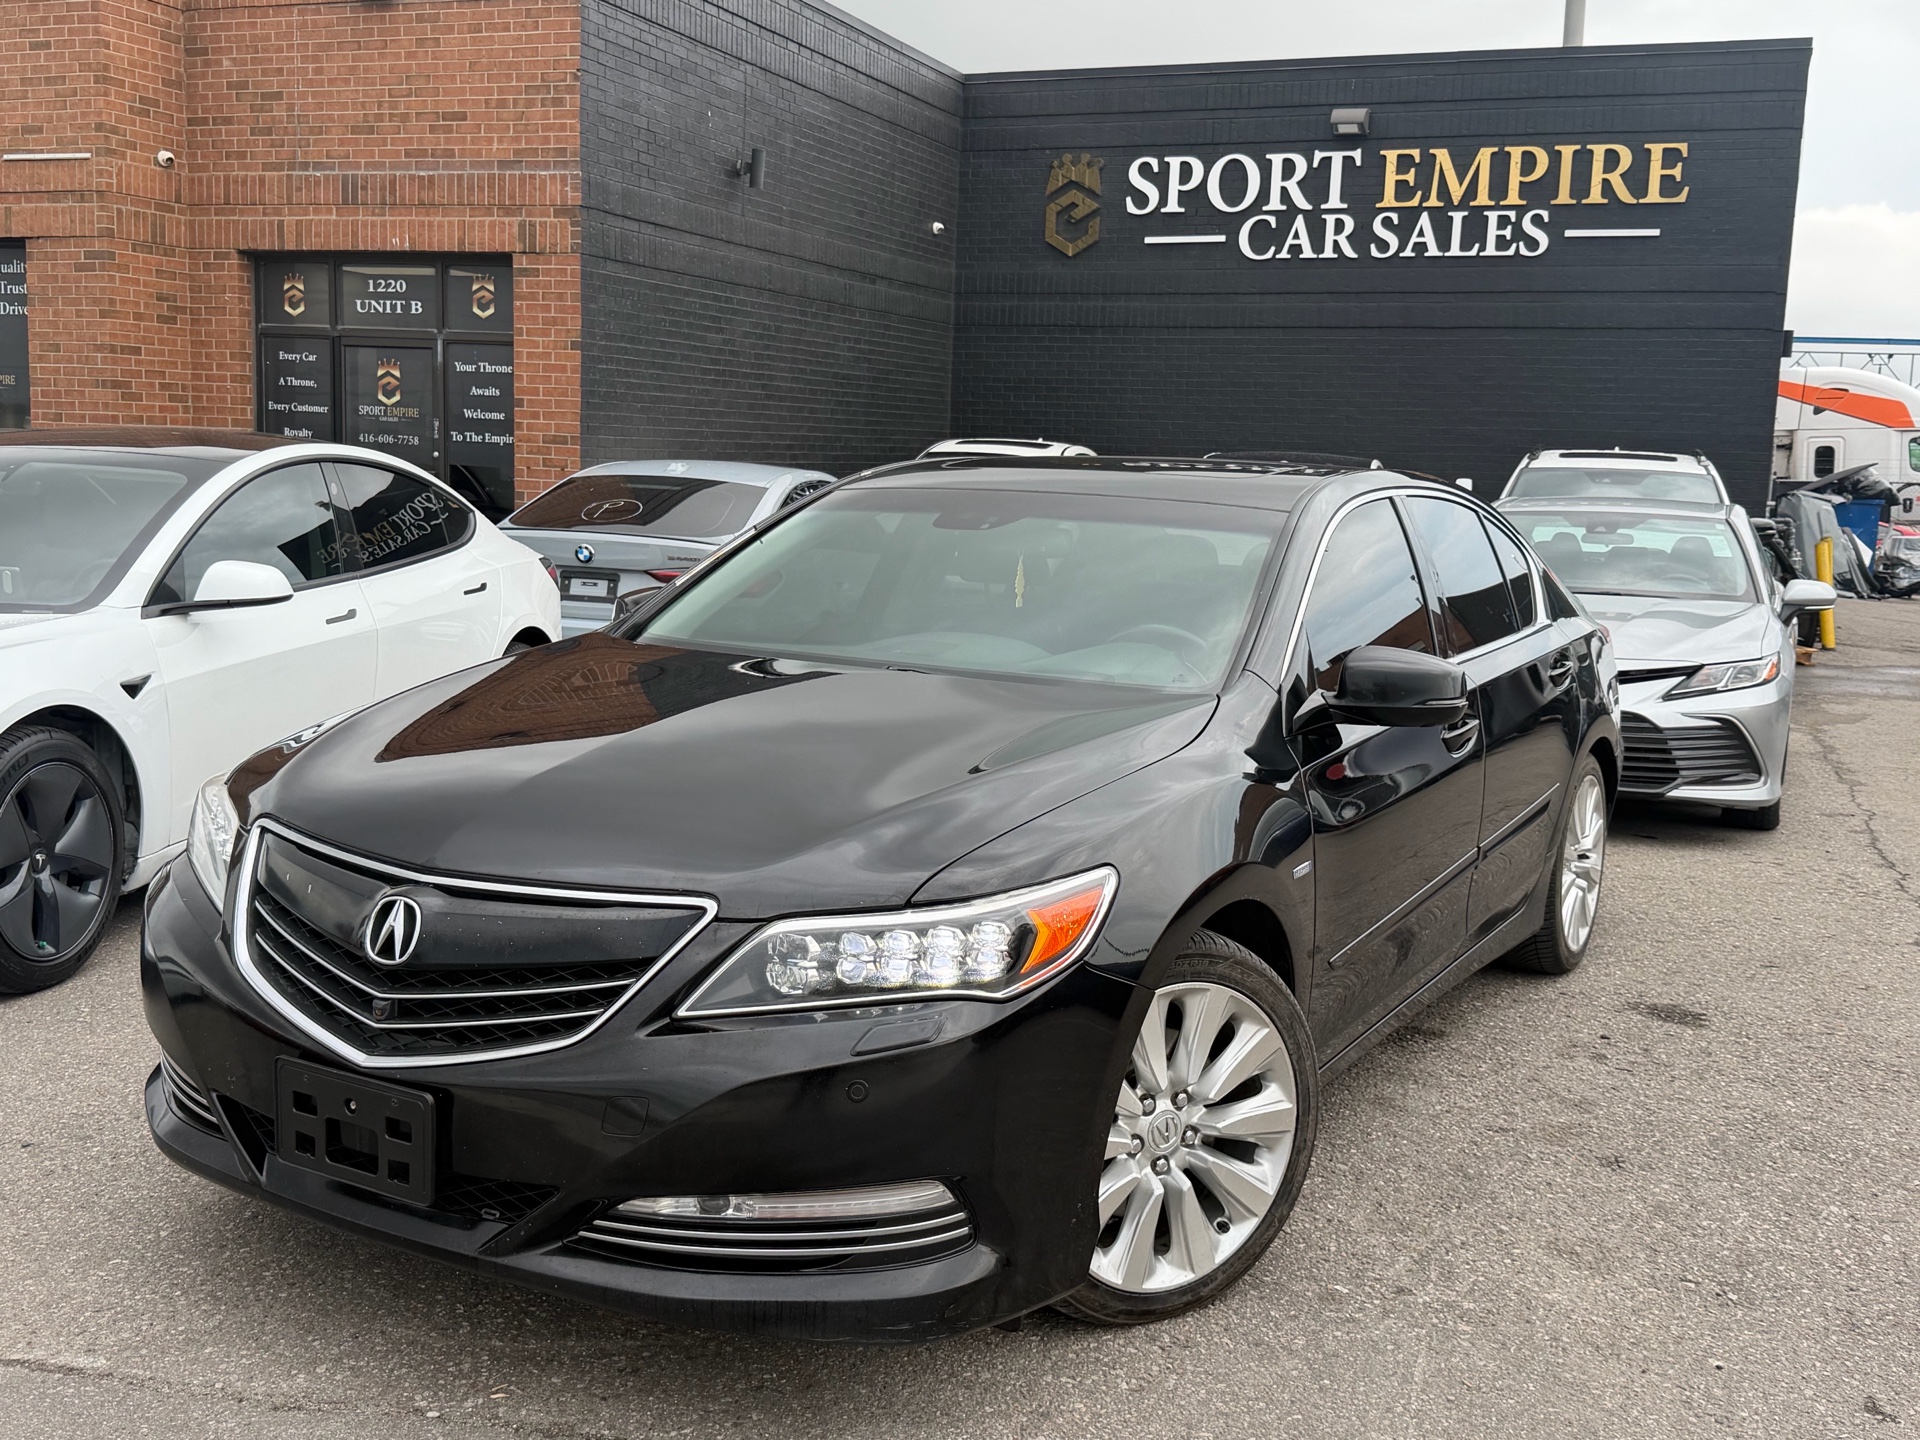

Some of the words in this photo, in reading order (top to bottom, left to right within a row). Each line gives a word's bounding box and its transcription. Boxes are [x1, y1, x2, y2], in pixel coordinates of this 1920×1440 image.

[1125, 147, 1362, 216] SPORT
[1375, 142, 1690, 208] EMPIRE
[1237, 214, 1358, 261] CAR
[1370, 209, 1550, 259] SALES
[0, 259, 27, 274] ualit
[367, 279, 407, 293] 1220
[355, 299, 406, 314] UNIT
[410, 300, 423, 314] B
[279, 351, 301, 363] Every
[302, 352, 317, 361] Car
[454, 362, 477, 372] Your
[478, 362, 513, 373] Throne
[0, 375, 16, 385] PIRE
[278, 377, 285, 386] A
[286, 377, 318, 388] Throne,
[470, 386, 501, 396] Awaits
[268, 401, 290, 413] Every
[291, 402, 329, 413] Customer
[358, 405, 386, 416] SPORT
[387, 406, 420, 418] EMPIRE
[463, 408, 506, 420] Welcome
[358, 433, 420, 446] 416-606-7758
[450, 431, 463, 442] To
[464, 432, 483, 443] The
